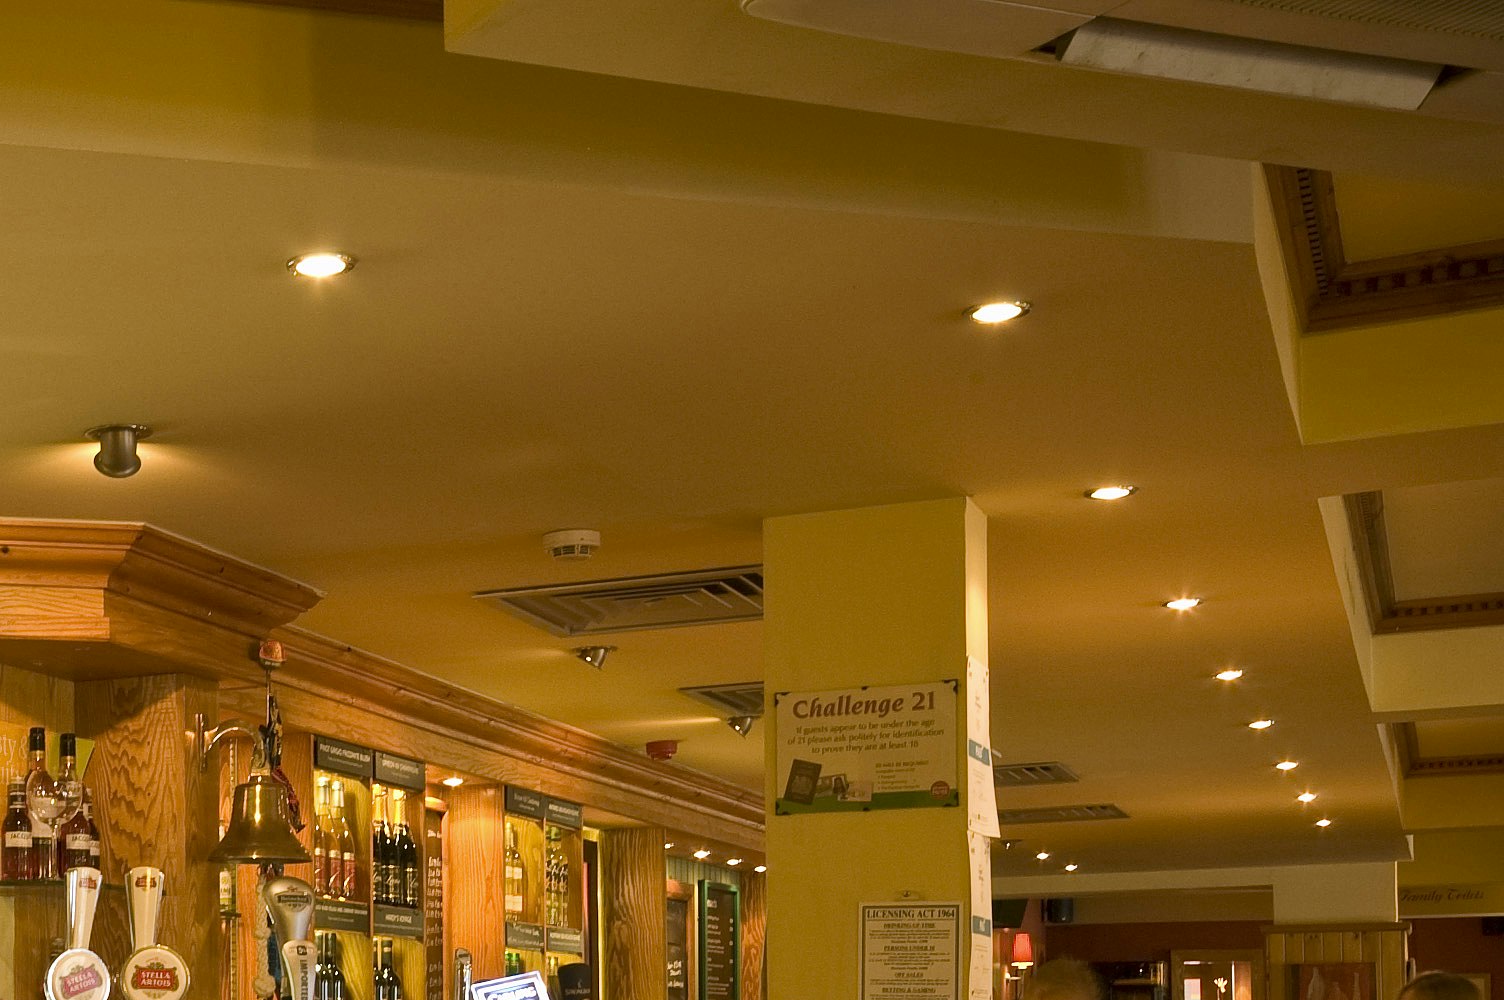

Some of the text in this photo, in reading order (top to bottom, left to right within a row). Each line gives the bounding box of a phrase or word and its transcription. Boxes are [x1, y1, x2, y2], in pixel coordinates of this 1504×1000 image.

[792, 691, 935, 719] Challenge 21
[803, 725, 828, 736] guests
[830, 723, 857, 735] appear
[858, 722, 867, 730] to
[868, 721, 879, 730] be
[880, 719, 904, 730] under
[906, 719, 919, 728] the
[920, 719, 936, 730] age
[787, 736, 797, 745] of
[807, 734, 833, 747] please
[848, 731, 877, 744] politely
[879, 730, 891, 740] for
[892, 728, 945, 740] identification
[18, 735, 28, 760] &
[811, 746, 820, 754] to
[821, 745, 844, 756] prove
[845, 743, 863, 755] they
[864, 743, 877, 751] are
[879, 742, 887, 750] at
[888, 740, 907, 750] least
[867, 909, 955, 919] LICENSING ACT 1964
[66, 971, 93, 987] STELLA
[140, 971, 171, 979] STELLA
[140, 978, 172, 987] ARTOIS
[68, 977, 96, 993] ARTOIS
